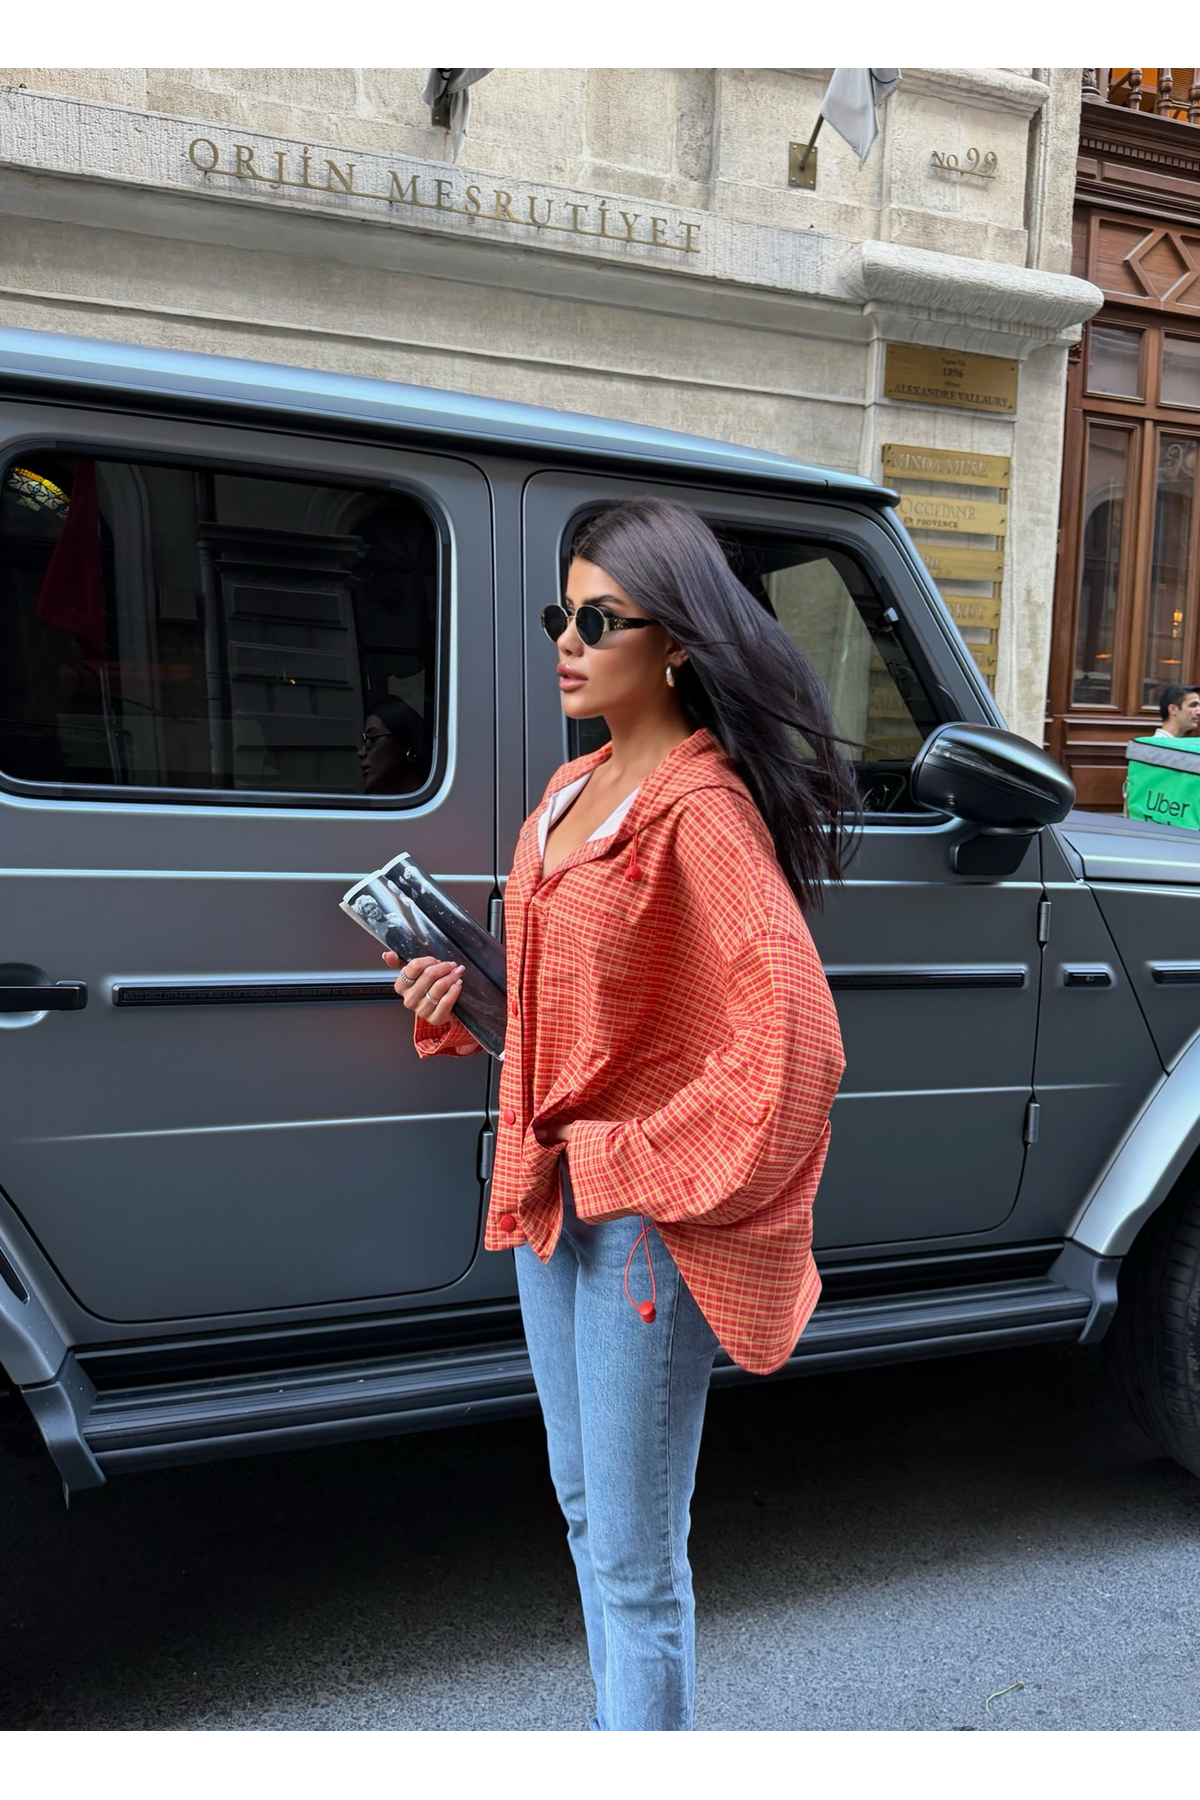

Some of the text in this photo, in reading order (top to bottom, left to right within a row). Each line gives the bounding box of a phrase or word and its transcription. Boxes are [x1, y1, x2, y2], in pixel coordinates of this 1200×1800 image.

[188, 137, 356, 194] ORJİN
[966, 147, 998, 176] 99
[894, 384, 957, 401] ALEXANDRE
[957, 391, 1009, 408] VALLAURY
[945, 459, 988, 478] MUSE
[916, 518, 958, 529] PROVENCE
[1146, 790, 1191, 818] Uber
